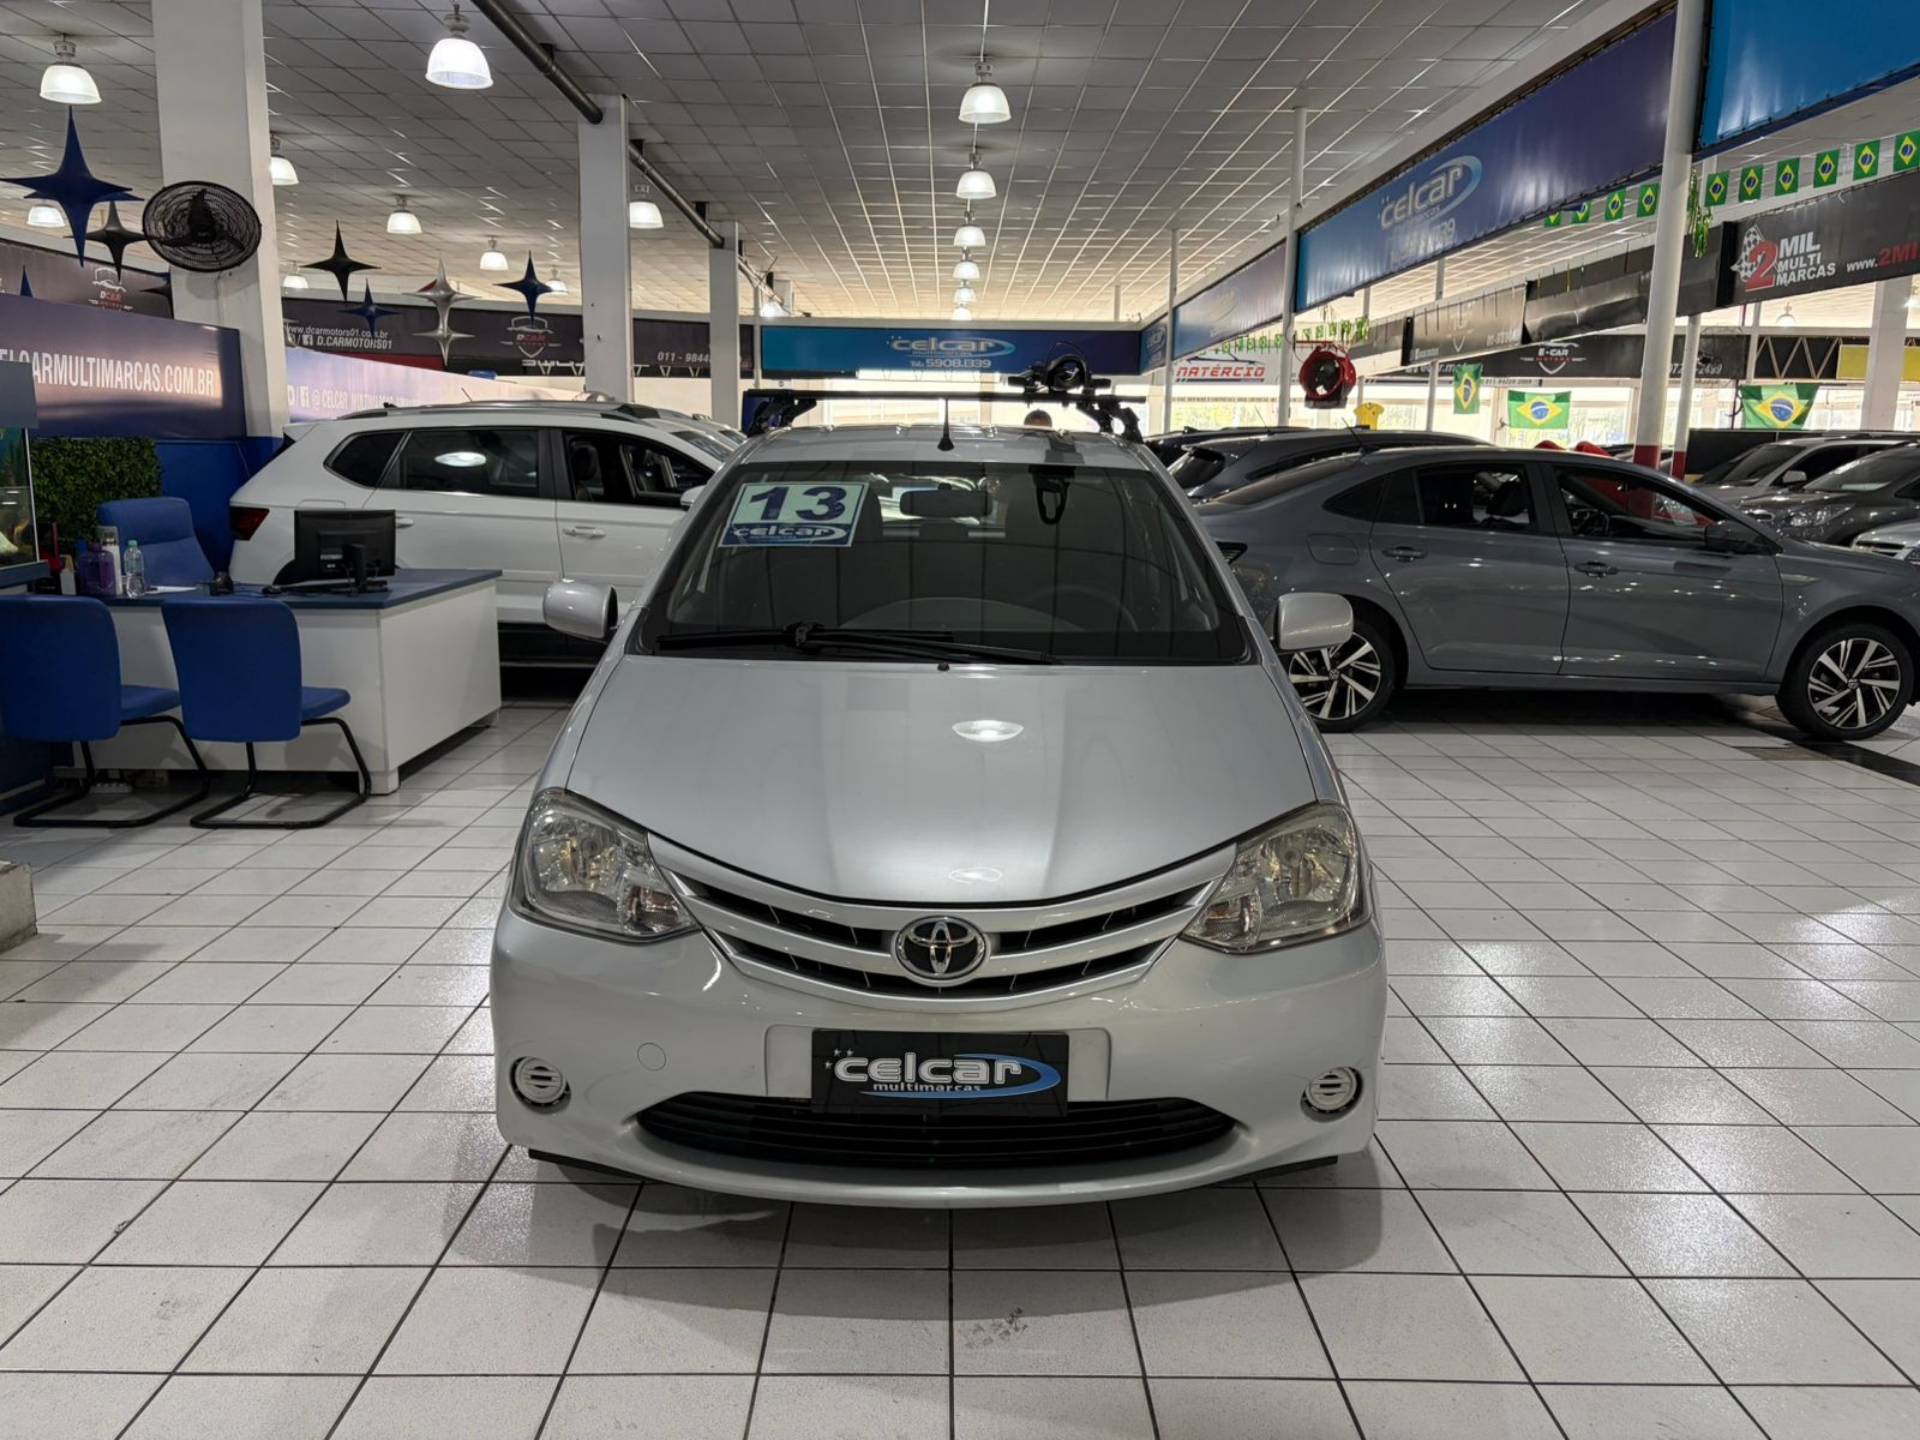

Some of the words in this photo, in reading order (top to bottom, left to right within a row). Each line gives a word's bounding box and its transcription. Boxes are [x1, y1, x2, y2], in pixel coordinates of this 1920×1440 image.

[1381, 166, 1463, 230] celcar
[1779, 232, 1821, 258] MIL
[1776, 263, 1837, 287] MARCAS
[1777, 252, 1822, 274] MULTI
[751, 487, 847, 520] 13
[733, 526, 830, 537] celcar
[834, 1052, 1022, 1084] celcar
[873, 1082, 981, 1092] multimarcas
